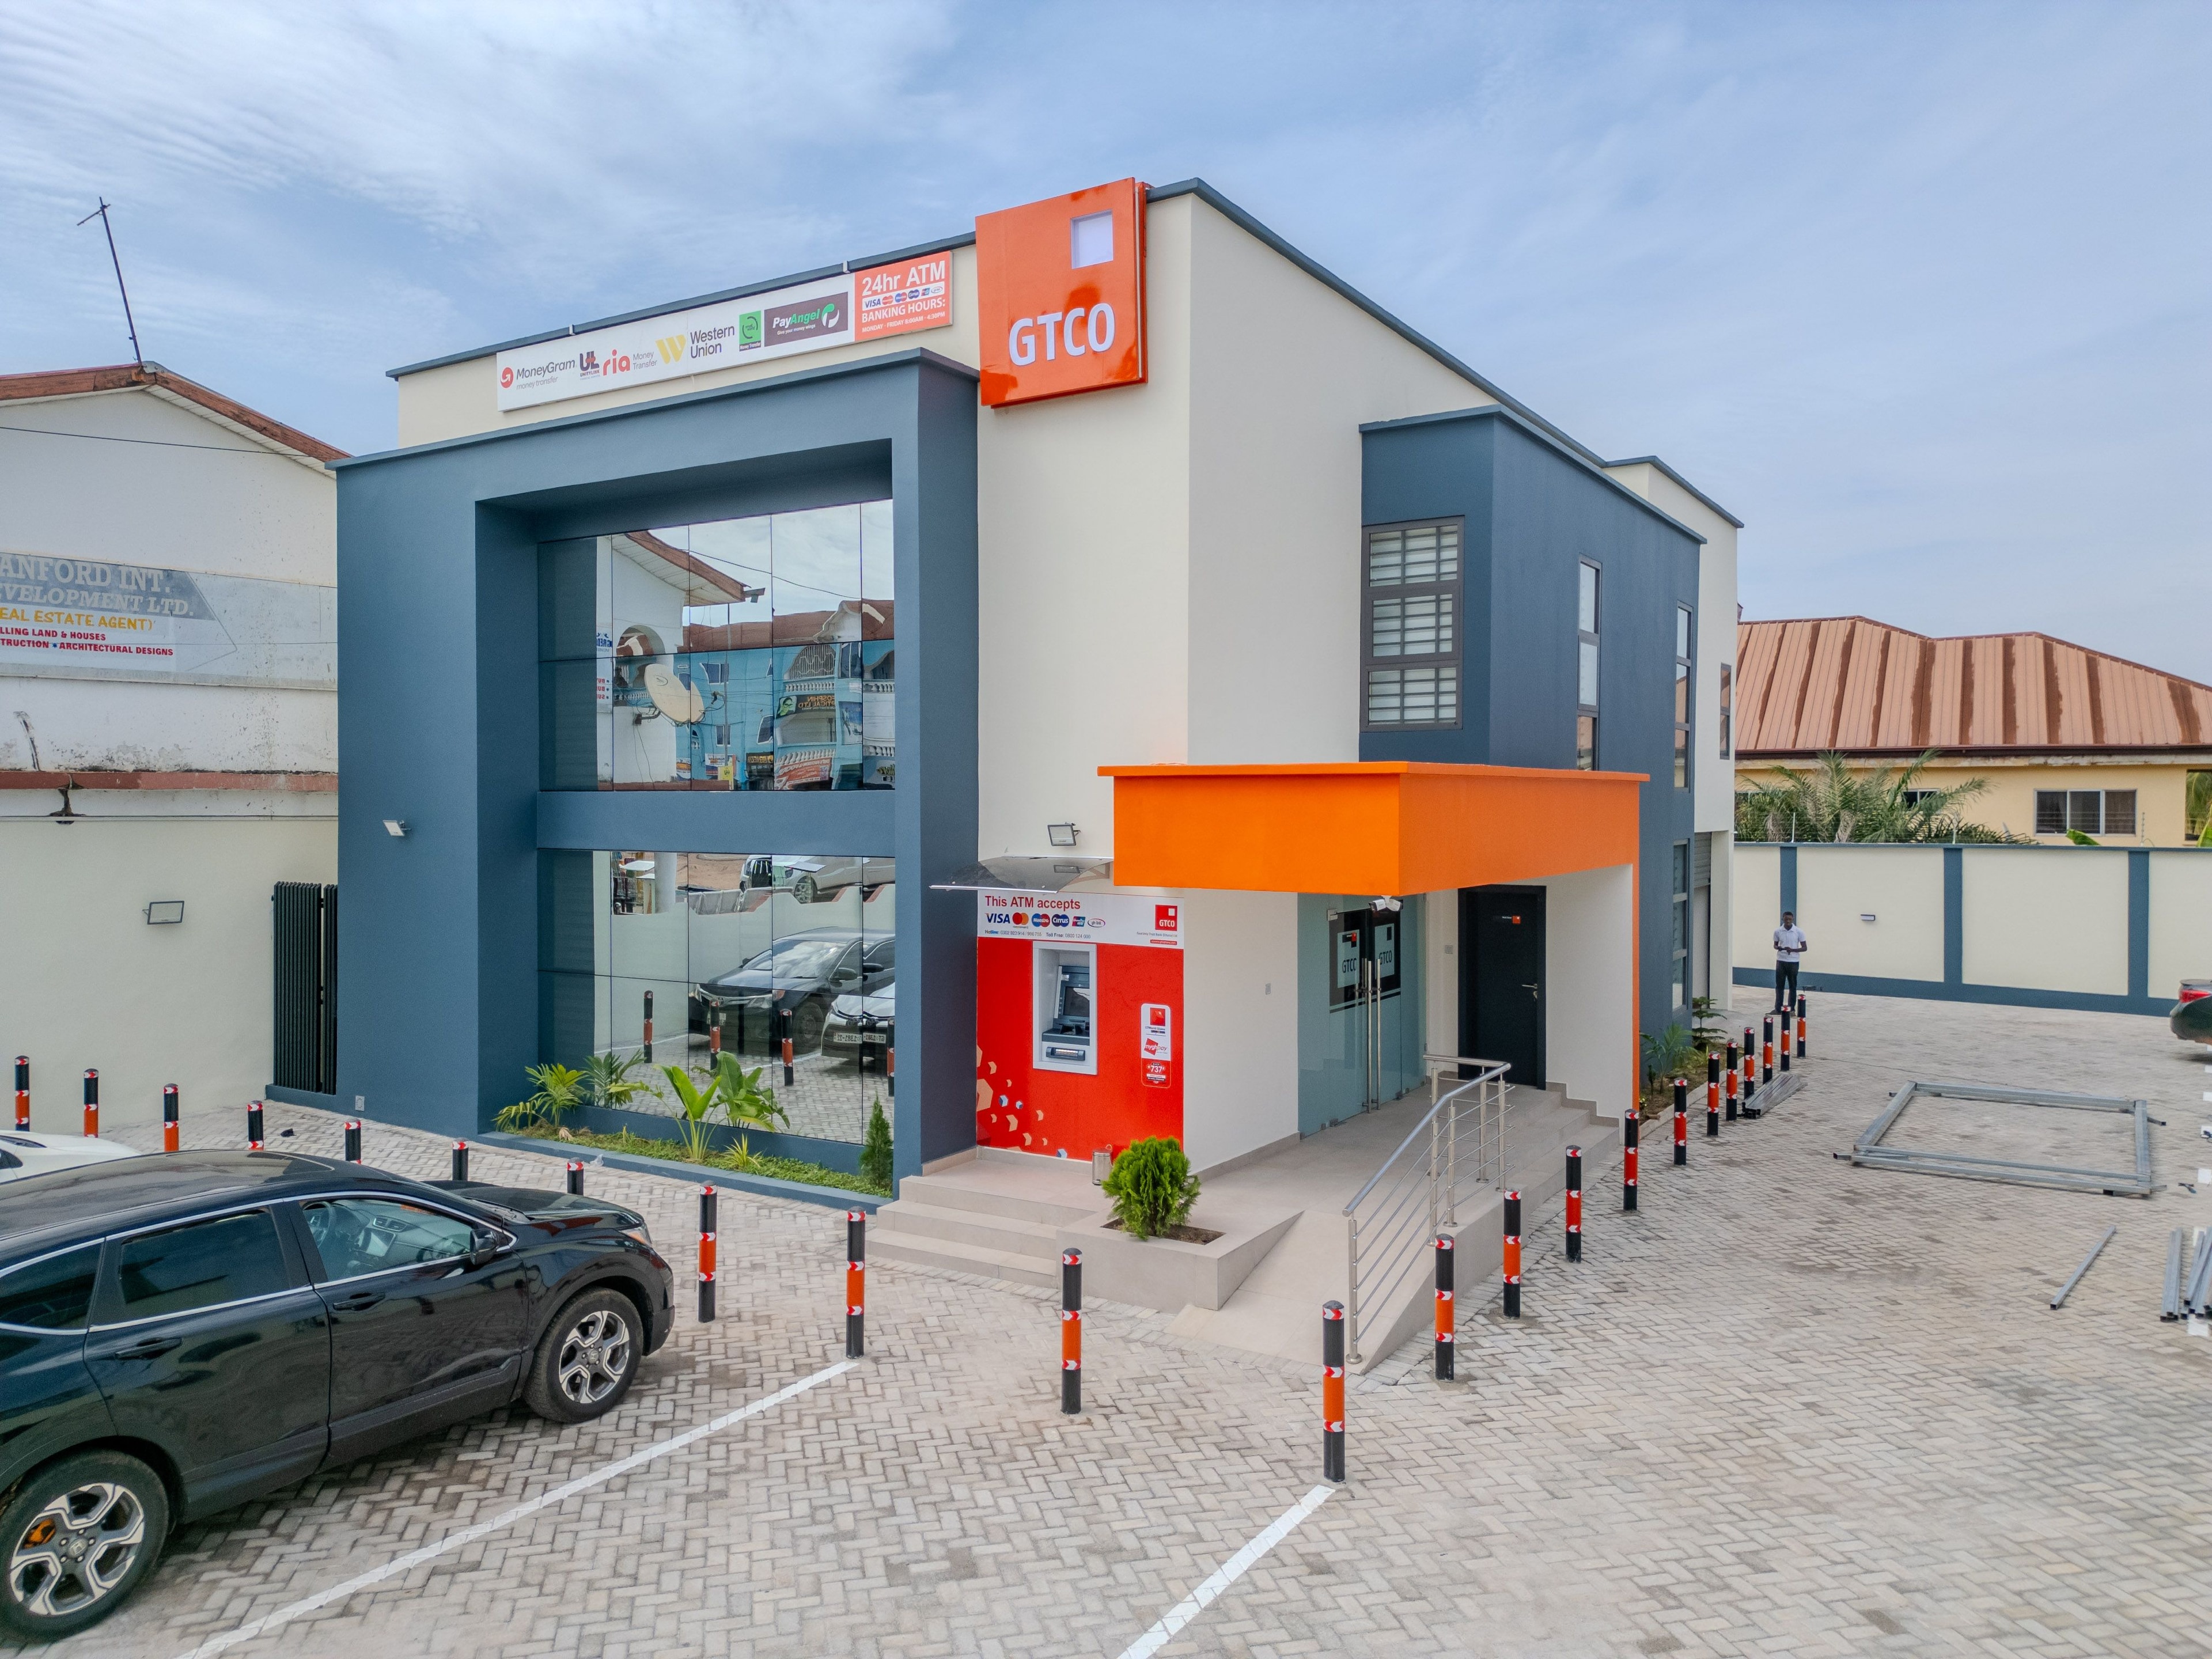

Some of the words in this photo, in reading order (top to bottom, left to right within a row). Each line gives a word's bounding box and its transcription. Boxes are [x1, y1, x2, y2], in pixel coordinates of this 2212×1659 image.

[862, 274, 900, 296] 24hr
[906, 260, 945, 287] ATM
[862, 305, 906, 323] BANKING
[908, 297, 945, 313] HOURS:
[865, 298, 881, 308] VISA
[772, 309, 820, 328] PayAngel
[862, 324, 883, 332] MONDAY
[887, 320, 904, 328] FRIDAY
[690, 325, 734, 344] Western
[1009, 302, 1115, 366] GTCO
[633, 351, 654, 361] Money
[691, 343, 722, 358] Union
[517, 359, 575, 380] MoneyGram
[603, 349, 630, 376] ria
[633, 359, 657, 370] Transfer
[516, 381, 535, 391] money
[536, 376, 558, 387] transfer
[119, 566, 171, 593] INT.
[0, 582, 143, 611] VELOPMENT
[147, 597, 194, 616] LTD.
[34, 610, 94, 627] ESTATE
[98, 616, 153, 631] AGENT)
[32, 628, 58, 637] LAND
[70, 631, 106, 641] HOUSES
[59, 642, 133, 653] ARCHITECTURAL
[136, 647, 173, 656] DESIGNS
[984, 896, 1007, 907] This
[1010, 896, 1033, 907] ATM
[1037, 899, 1081, 911] accepts
[985, 913, 1010, 924] VISA
[1159, 919, 1175, 927] GTCO
[1379, 950, 1392, 965] GTCO
[1342, 958, 1357, 973] GTCO
